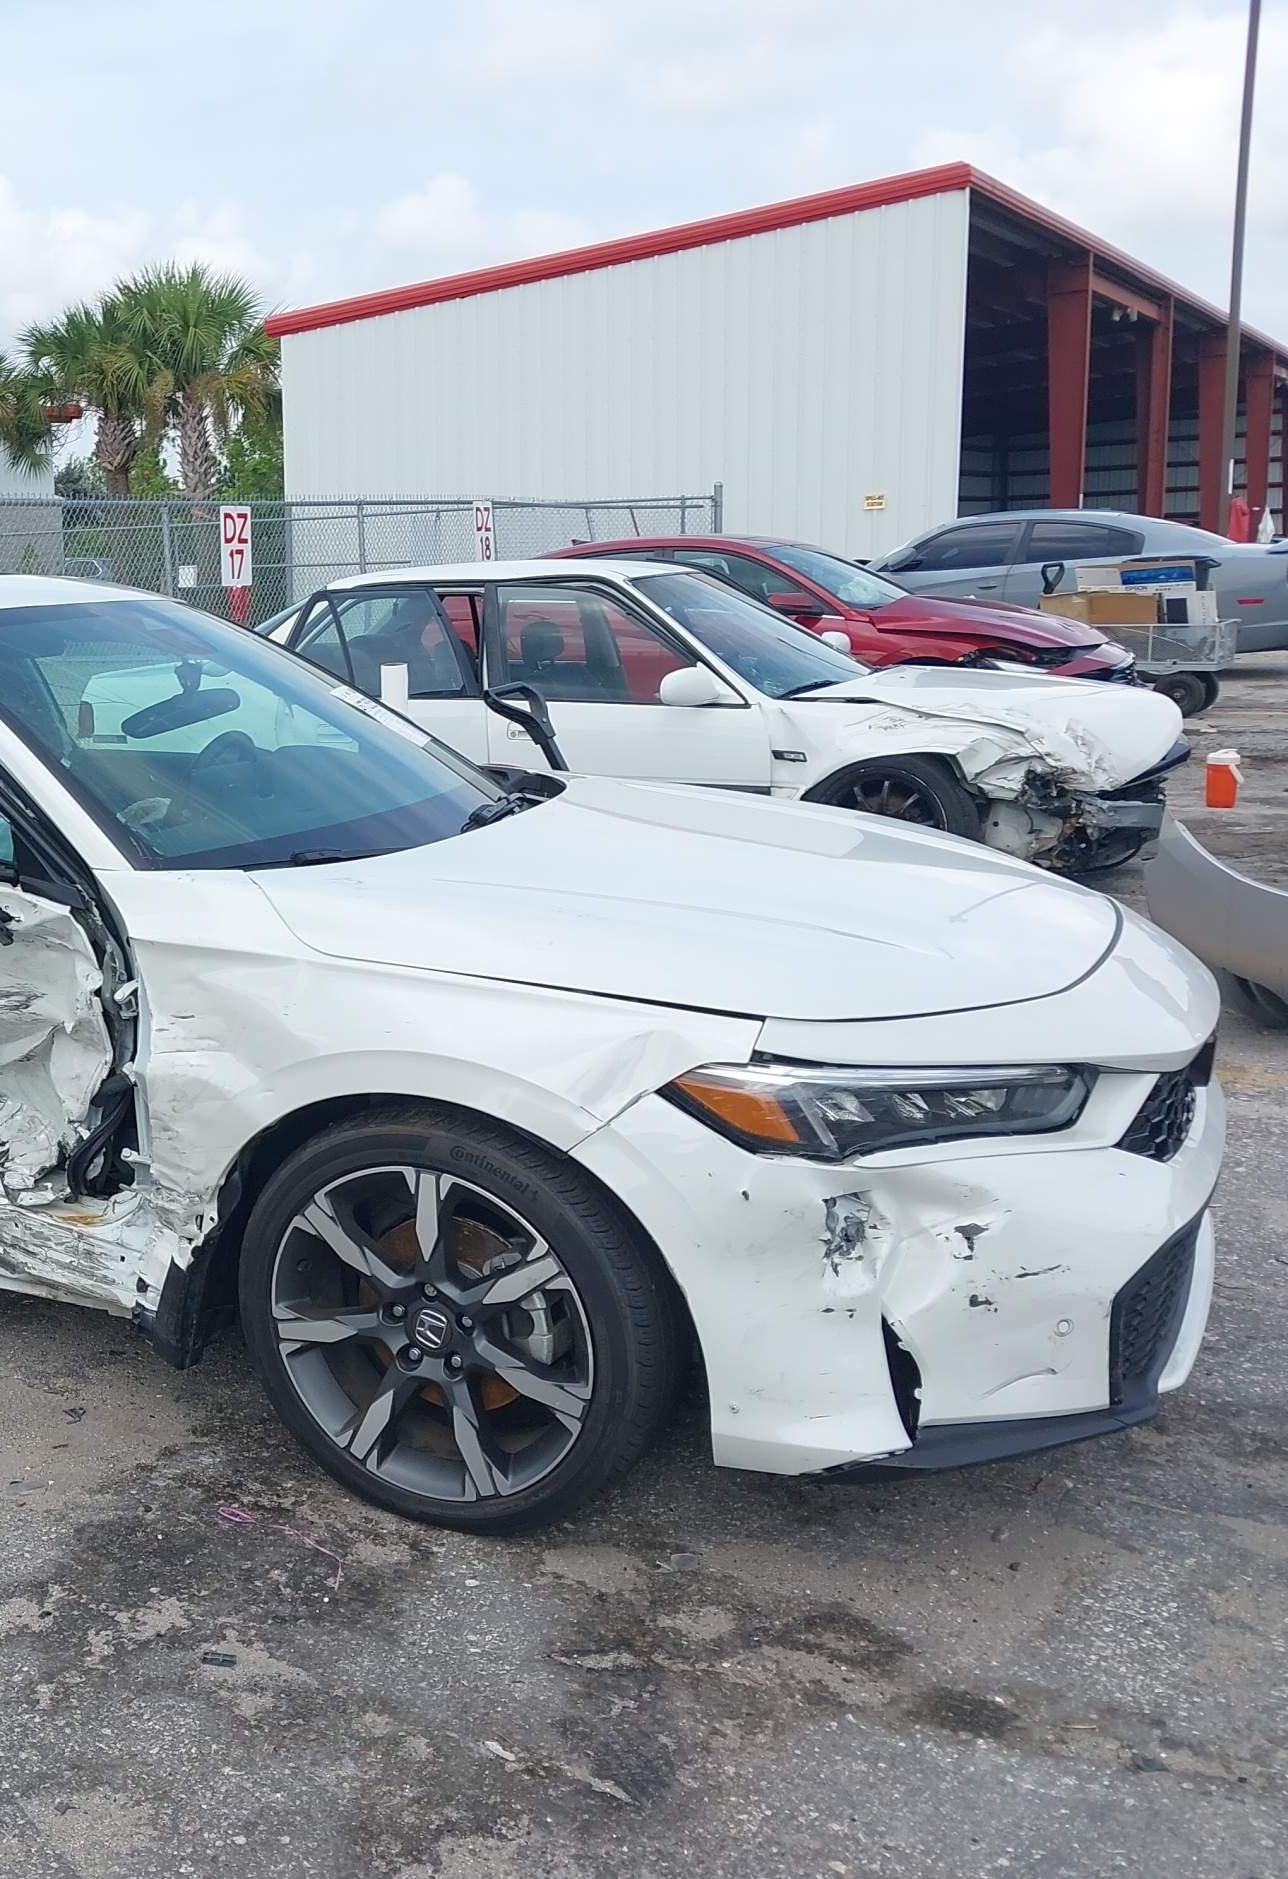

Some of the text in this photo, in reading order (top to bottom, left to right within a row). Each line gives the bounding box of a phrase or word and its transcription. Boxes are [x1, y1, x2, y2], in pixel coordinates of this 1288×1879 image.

[223, 512, 249, 544] DZ
[475, 506, 492, 532] DZ
[480, 535, 492, 561] 18
[229, 549, 245, 579] 17
[450, 1145, 530, 1194] Continental
